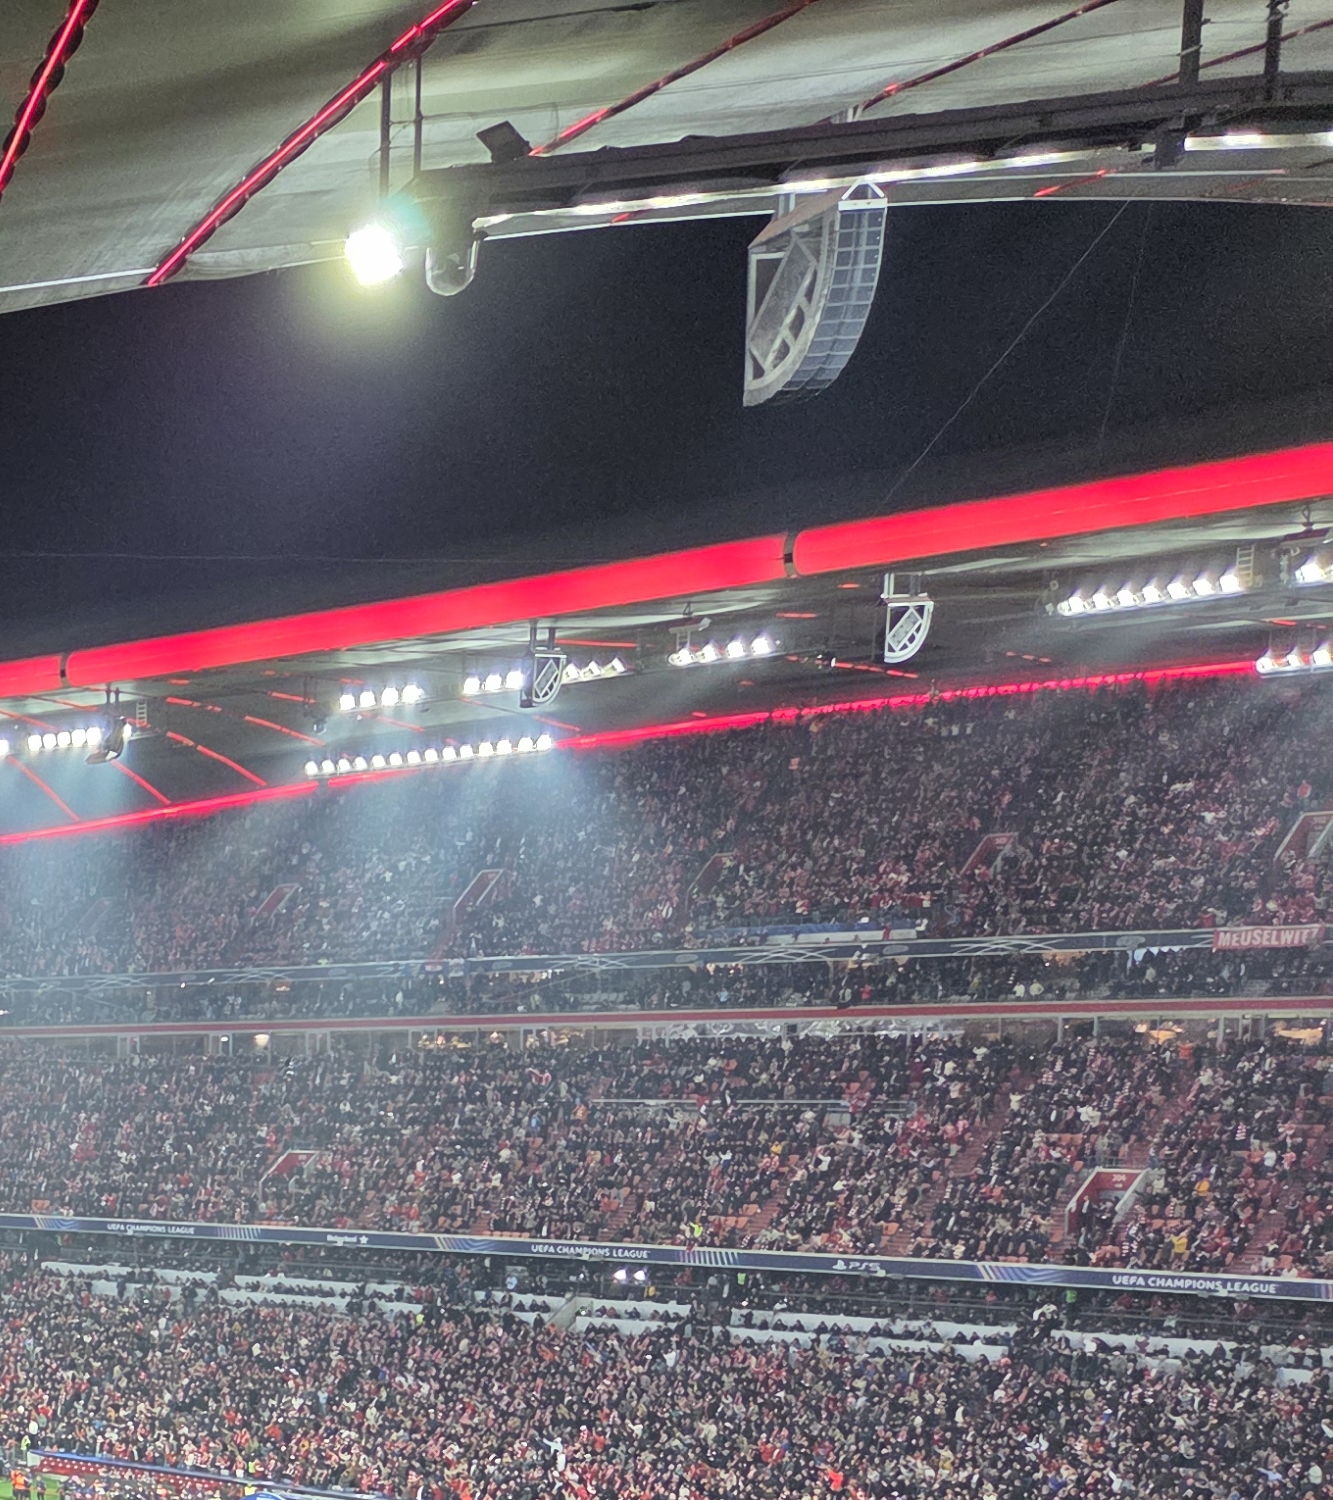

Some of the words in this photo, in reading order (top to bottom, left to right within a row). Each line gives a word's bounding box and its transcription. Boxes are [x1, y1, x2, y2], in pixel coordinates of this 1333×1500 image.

[167, 1225, 195, 1235] LEAGUE
[531, 1244, 555, 1254] UEFA
[556, 1245, 610, 1257] CHAMPIONS
[612, 1248, 649, 1259] LEAGUE
[1112, 1275, 1145, 1287] UEFA
[1147, 1276, 1222, 1291] CHAMPIONS
[1226, 1281, 1277, 1294] LEAGUE
